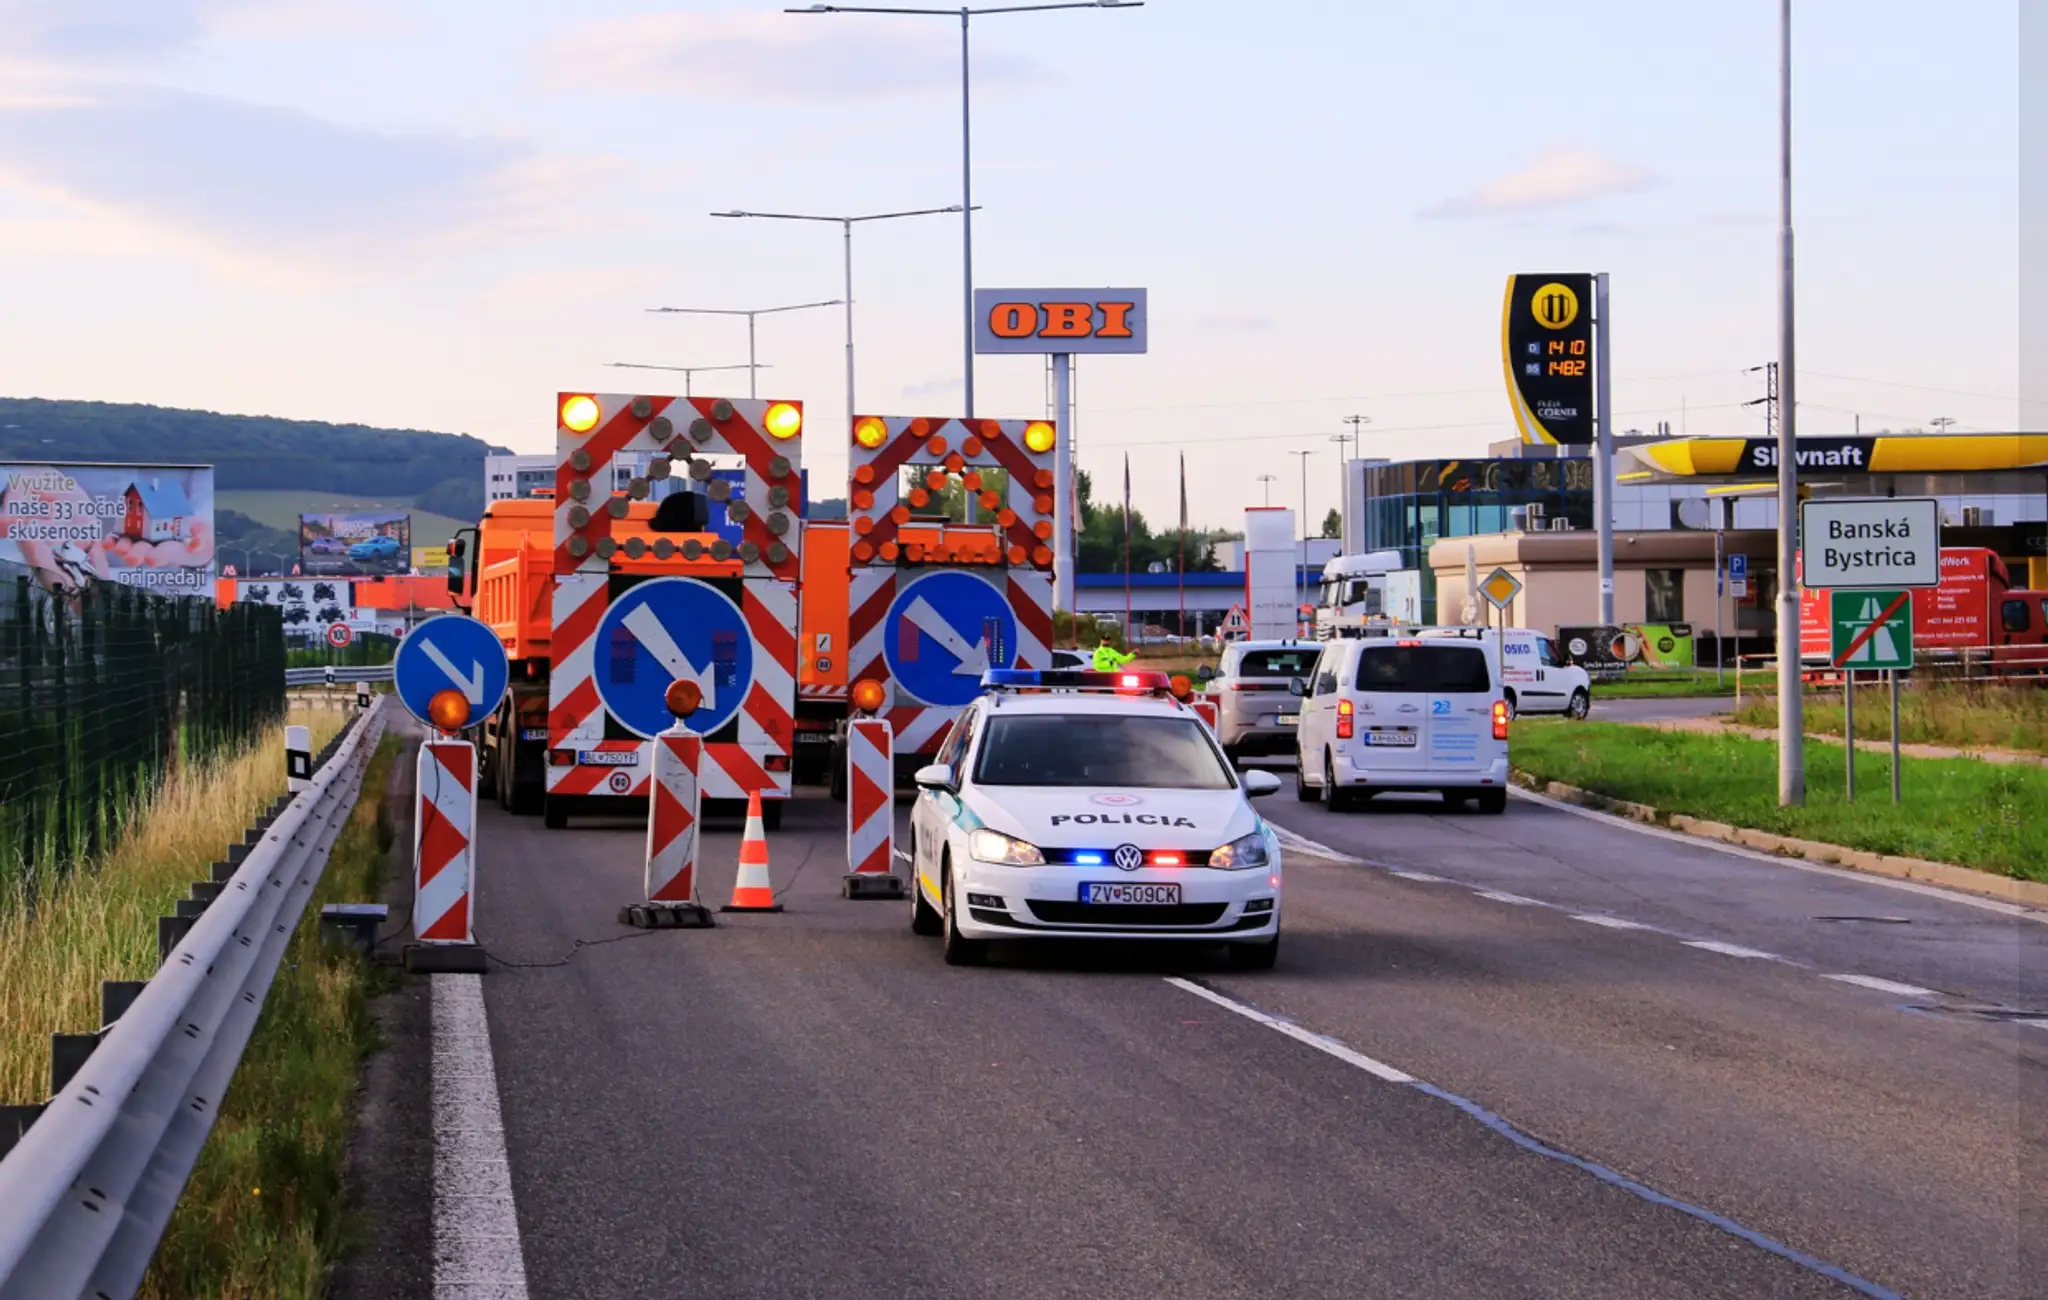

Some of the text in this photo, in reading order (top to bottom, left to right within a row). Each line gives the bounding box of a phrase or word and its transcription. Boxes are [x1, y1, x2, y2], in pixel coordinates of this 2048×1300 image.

[989, 302, 1134, 339] OBI
[1548, 360, 1586, 376] 1482
[1537, 408, 1578, 417] CORNER
[1753, 445, 1862, 466] Slvnaft
[9, 472, 74, 496] Využite
[9, 496, 125, 520] naše 33 ročné
[8, 520, 100, 540] skúsenosti
[1829, 517, 1910, 539] Banská
[1825, 546, 1916, 572] Bystrica
[1941, 556, 1970, 567] dWork
[120, 567, 206, 592] pri predaji
